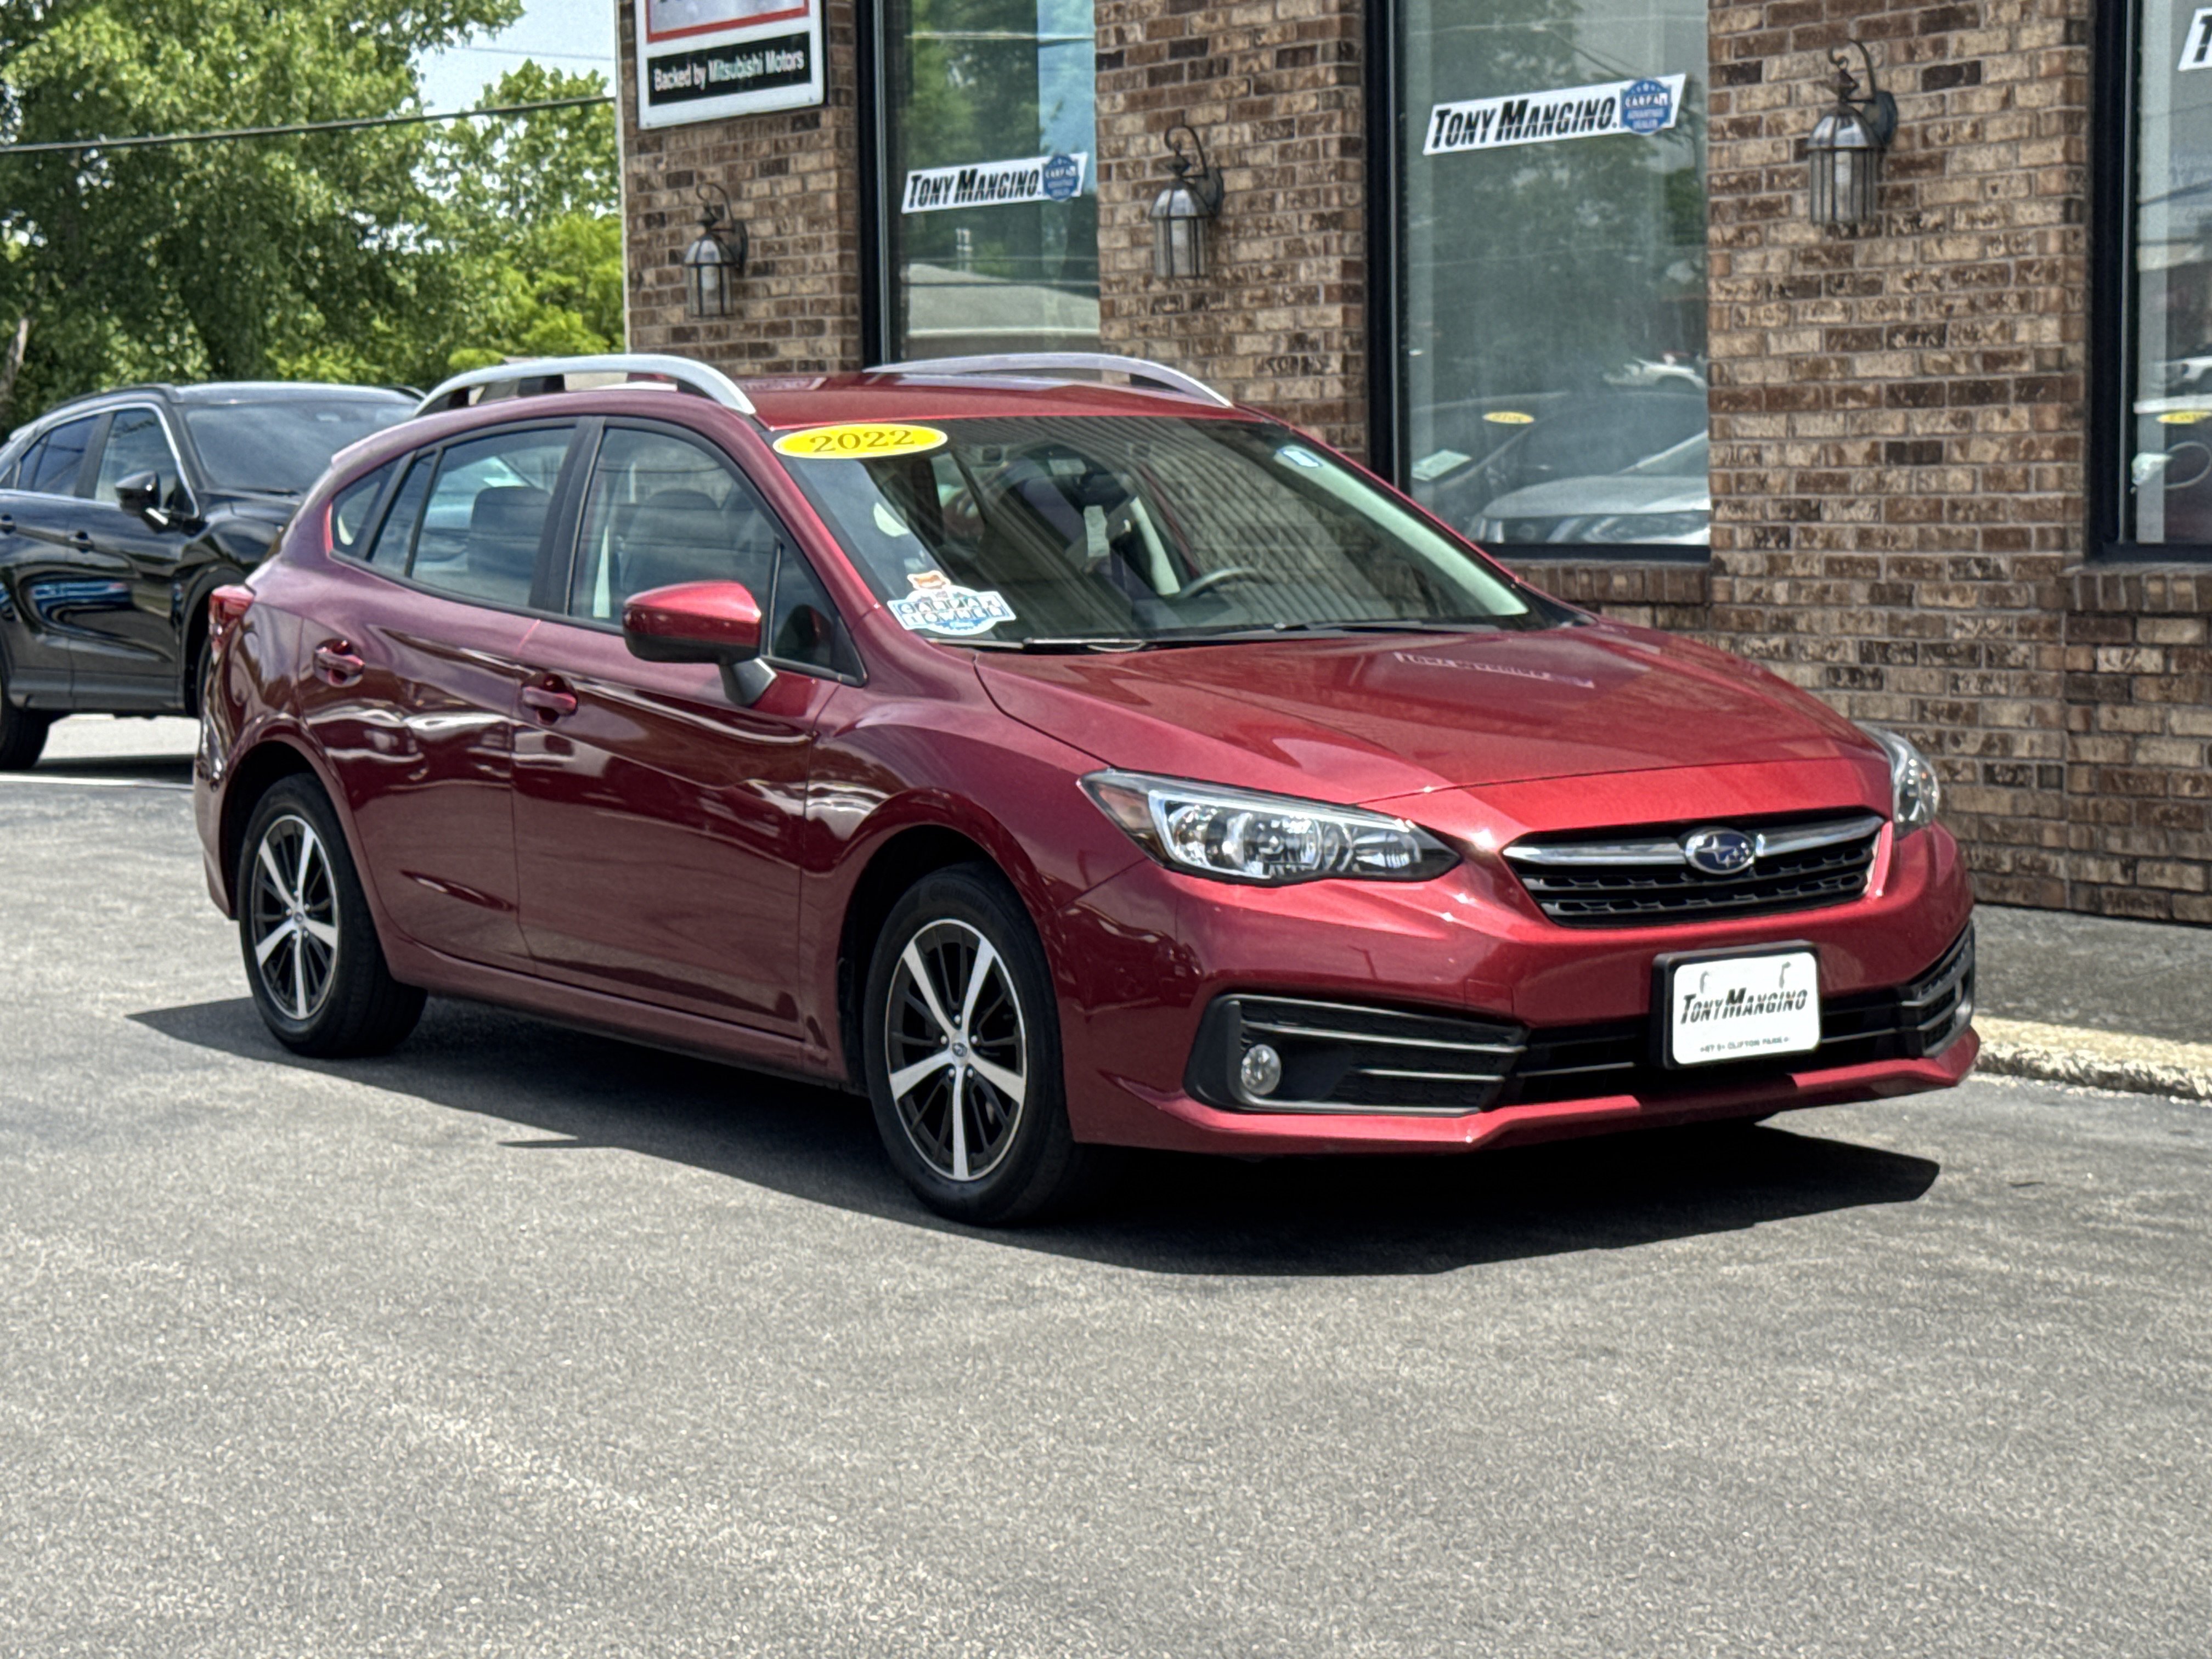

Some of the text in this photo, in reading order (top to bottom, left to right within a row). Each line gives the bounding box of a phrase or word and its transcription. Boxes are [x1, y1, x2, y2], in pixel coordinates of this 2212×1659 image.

[654, 49, 804, 92] Backed by Mitsubishi Motors
[809, 430, 915, 453] 2022
